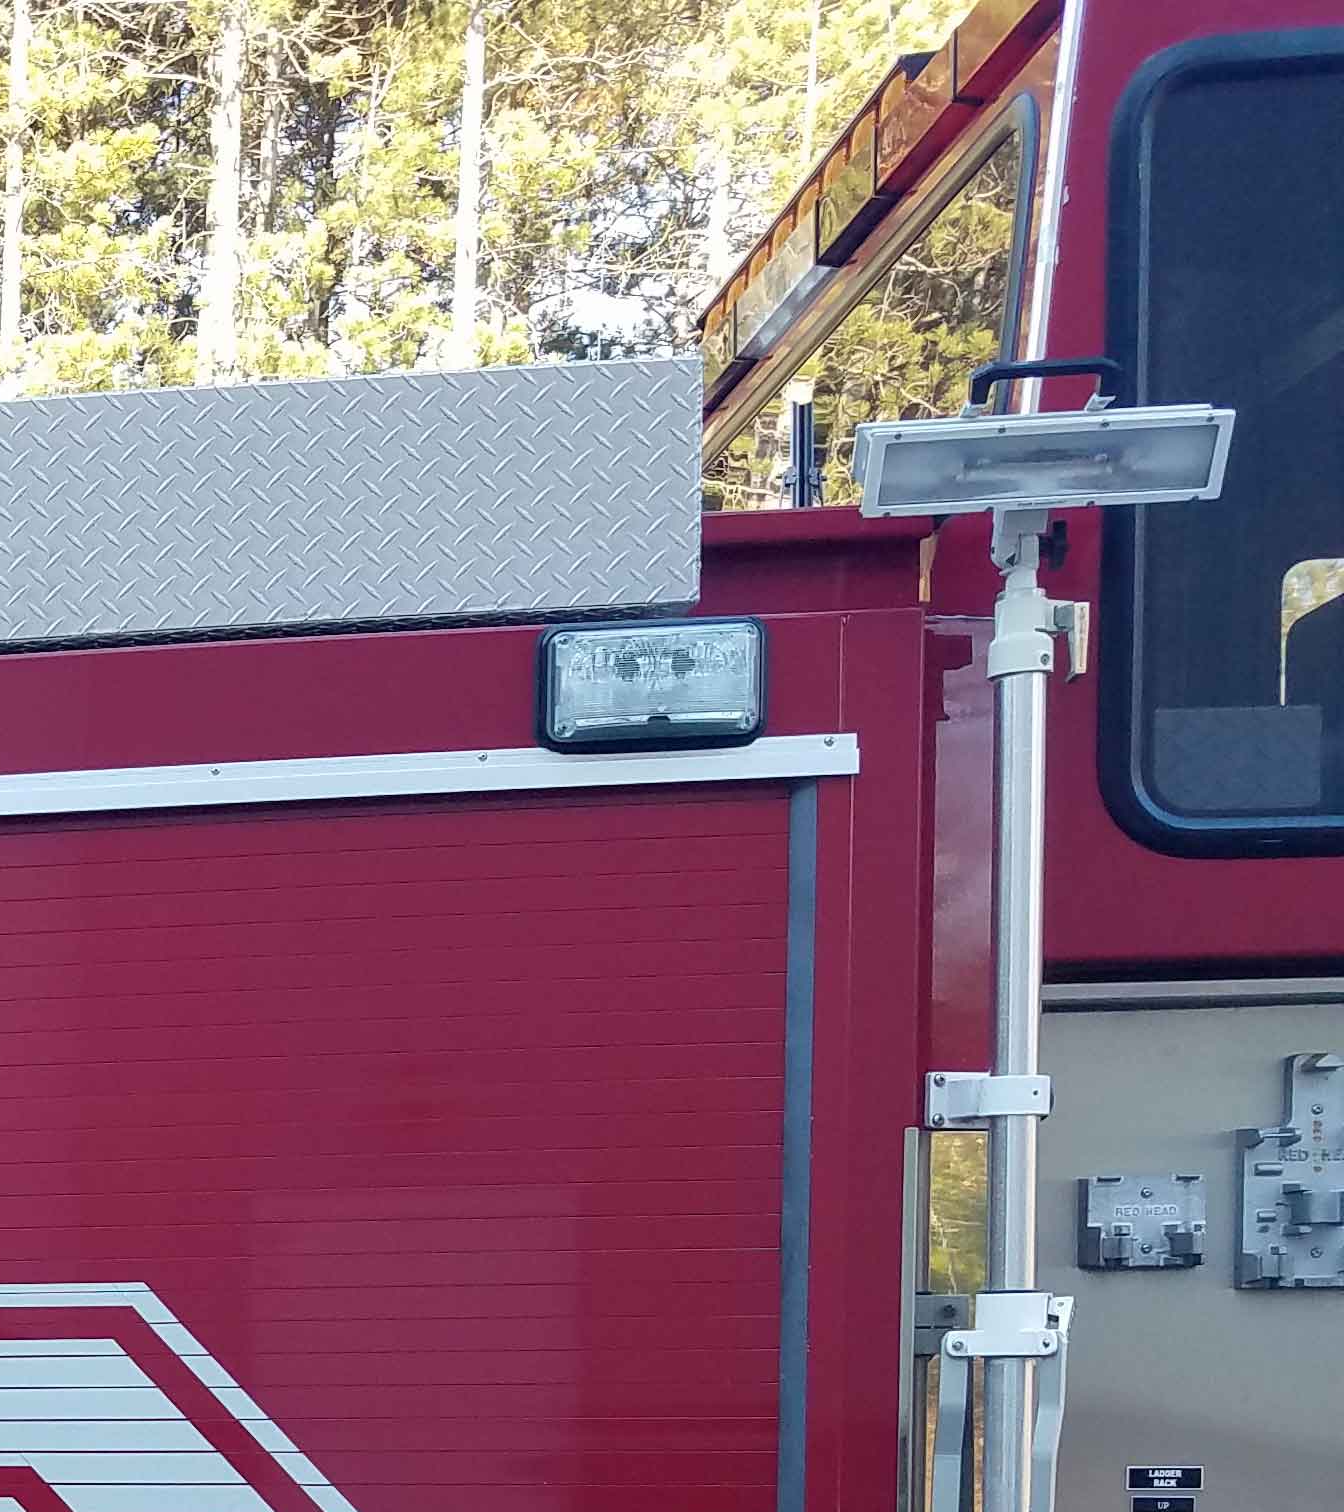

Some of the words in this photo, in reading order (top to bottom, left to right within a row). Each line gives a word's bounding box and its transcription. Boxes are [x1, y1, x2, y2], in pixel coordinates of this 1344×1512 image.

[1279, 1149, 1308, 1161] RED
[1115, 1207, 1140, 1217] RED
[1145, 1205, 1177, 1216] HEAD
[1157, 1502, 1170, 1510] UP
